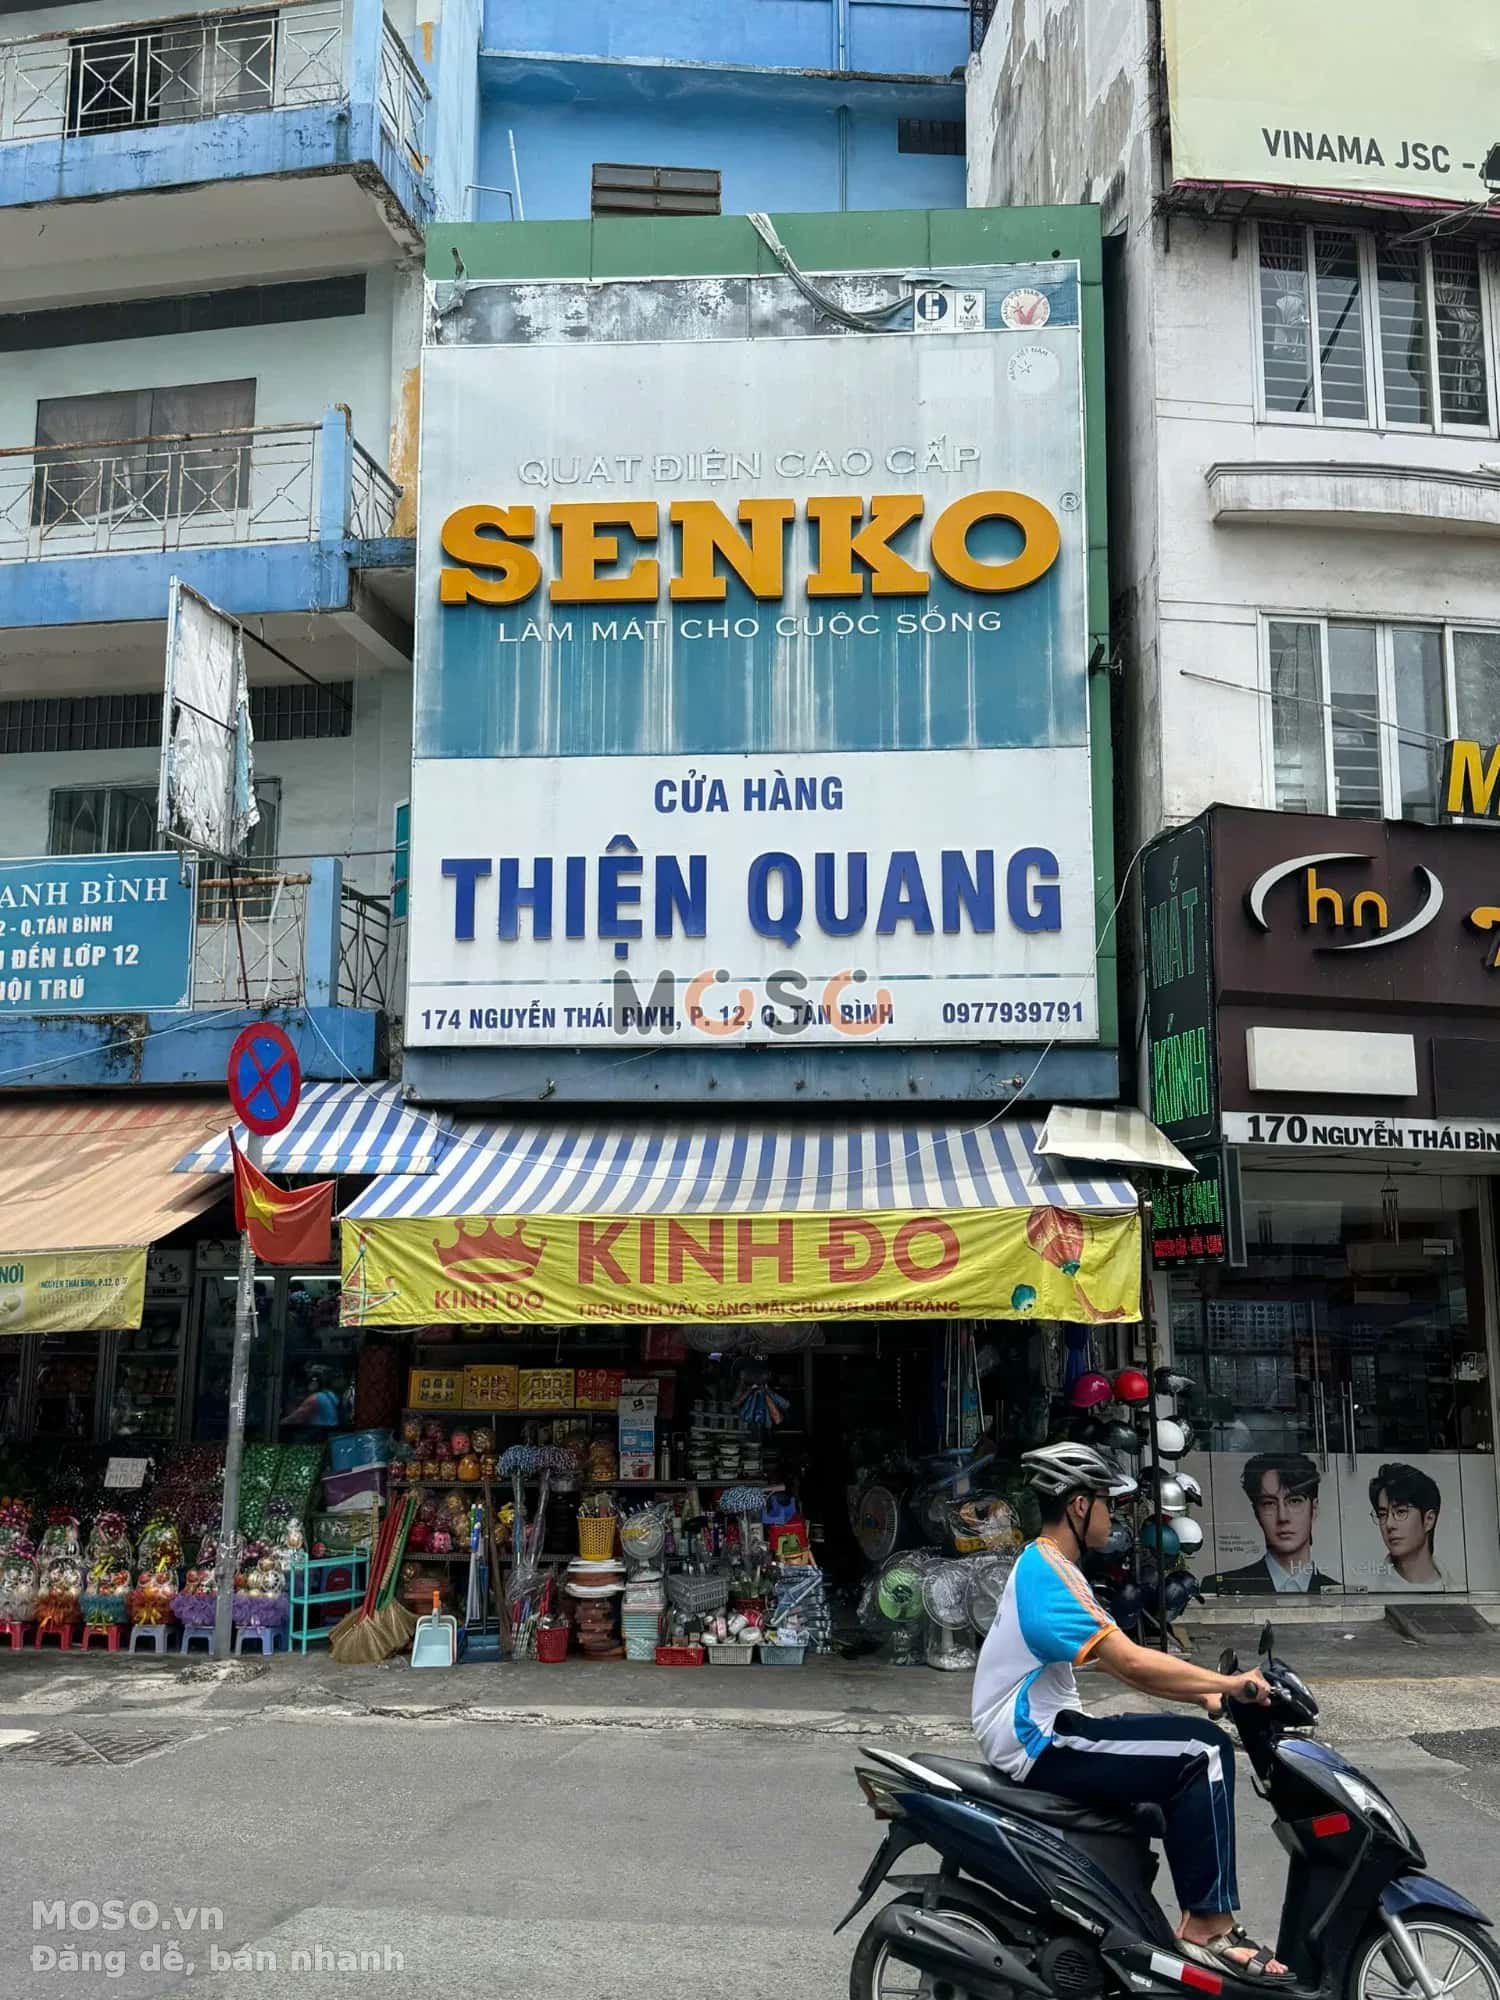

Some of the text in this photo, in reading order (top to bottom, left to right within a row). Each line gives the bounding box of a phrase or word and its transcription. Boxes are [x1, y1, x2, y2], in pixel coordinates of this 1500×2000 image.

[1262, 128, 1384, 166] VINAMA
[1395, 141, 1451, 173] JSC
[652, 445, 761, 487] ĐIỆN
[774, 447, 873, 479] CAO
[885, 433, 981, 475] CẤP
[439, 490, 1062, 606] SENKO
[498, 604, 1002, 643] LÀM MÁT CHO CUỘC SỐNG
[654, 768, 844, 813] CỬA HÀNG
[79, 873, 169, 905] BÌNH
[441, 833, 1063, 960] THIỆN QUANG
[20, 915, 68, 937] Q.TÂN
[72, 914, 113, 934] BÌNH
[1151, 856, 1199, 990] MẮT
[11, 941, 57, 970] ĐẾN
[63, 942, 106, 968] LỚP
[112, 944, 140, 966] 12
[38, 974, 86, 1001] TRÚ
[421, 1009, 461, 1030] 174
[469, 1000, 556, 1029] NGUYỄN
[563, 1003, 613, 1028] THÁI
[621, 1000, 682, 1030] BÌNH,
[690, 1006, 711, 1026] P.
[720, 1004, 753, 1030] 12,
[792, 999, 832, 1026] TÂN
[840, 999, 895, 1025] BÌNH
[942, 1001, 1083, 1024] 0977939791
[1153, 1013, 1209, 1124] KÍNH
[1247, 1115, 1308, 1144] 170
[1312, 1120, 1403, 1147] NGUYỄN
[1408, 1125, 1461, 1150] THÁI
[577, 1218, 794, 1285] KINH
[434, 1290, 498, 1310] KINH
